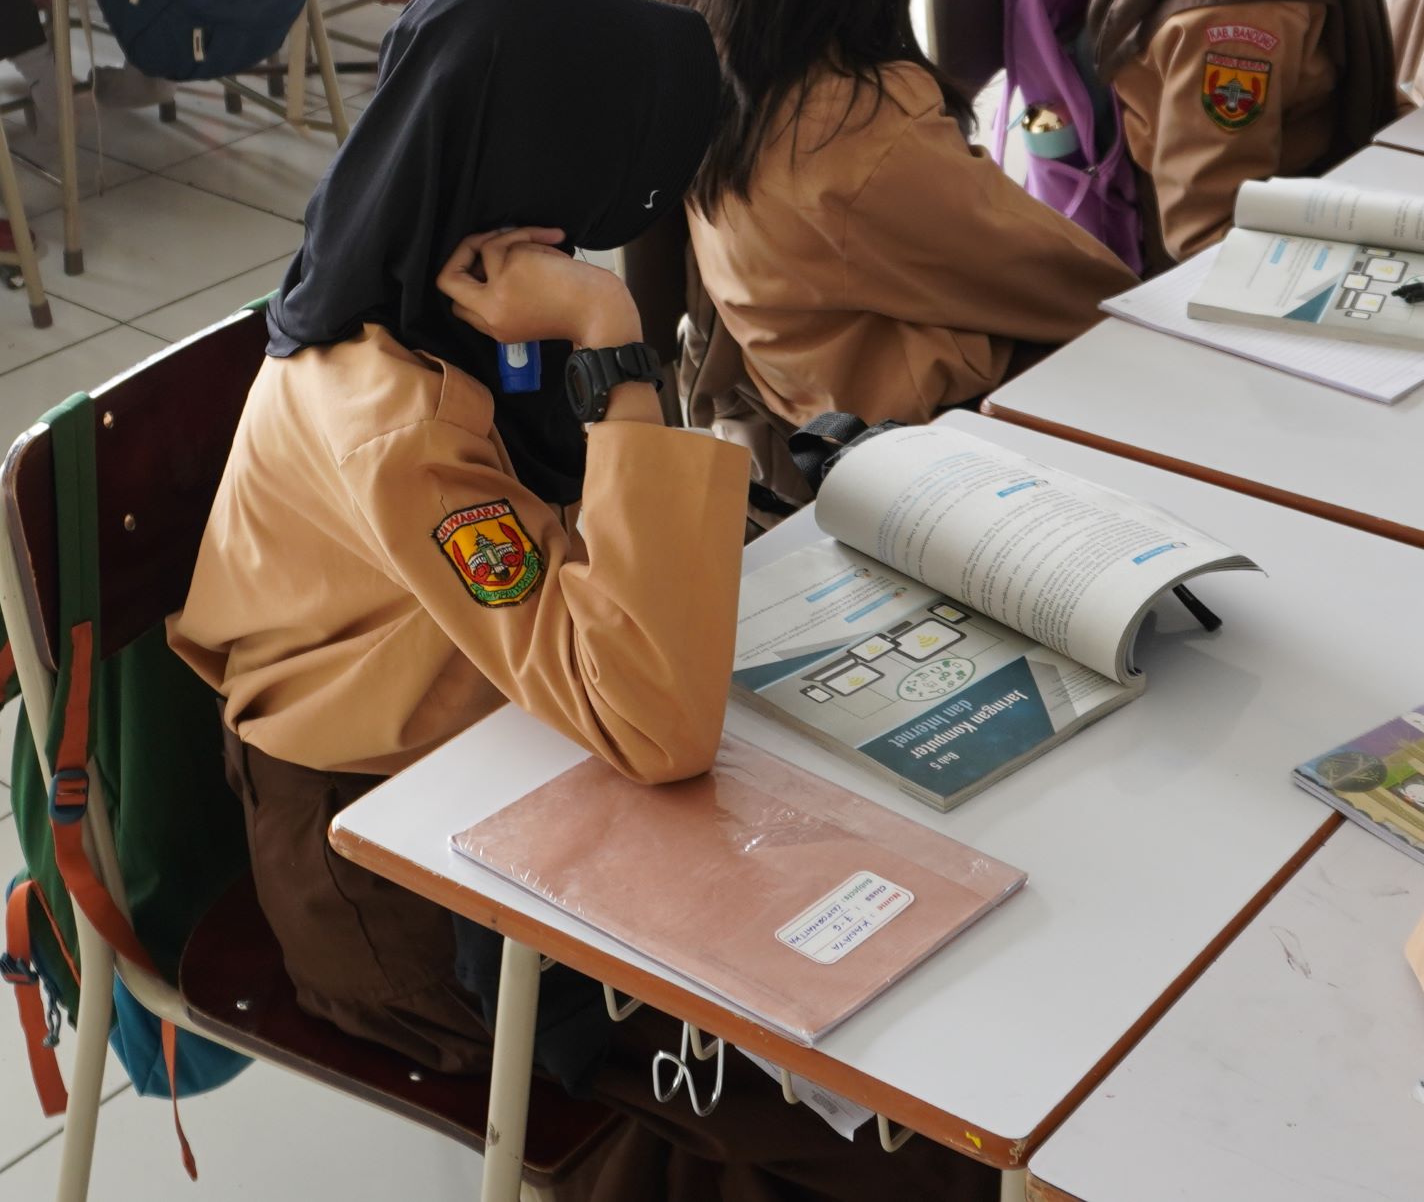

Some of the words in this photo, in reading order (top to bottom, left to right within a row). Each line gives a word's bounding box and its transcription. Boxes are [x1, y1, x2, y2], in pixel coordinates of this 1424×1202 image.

[943, 699, 973, 718] dan
[970, 689, 1029, 725] Jaringan
[887, 713, 951, 749] Internet
[910, 720, 978, 760] Komputer
[929, 761, 943, 771] 5
[937, 751, 961, 766] Bab
